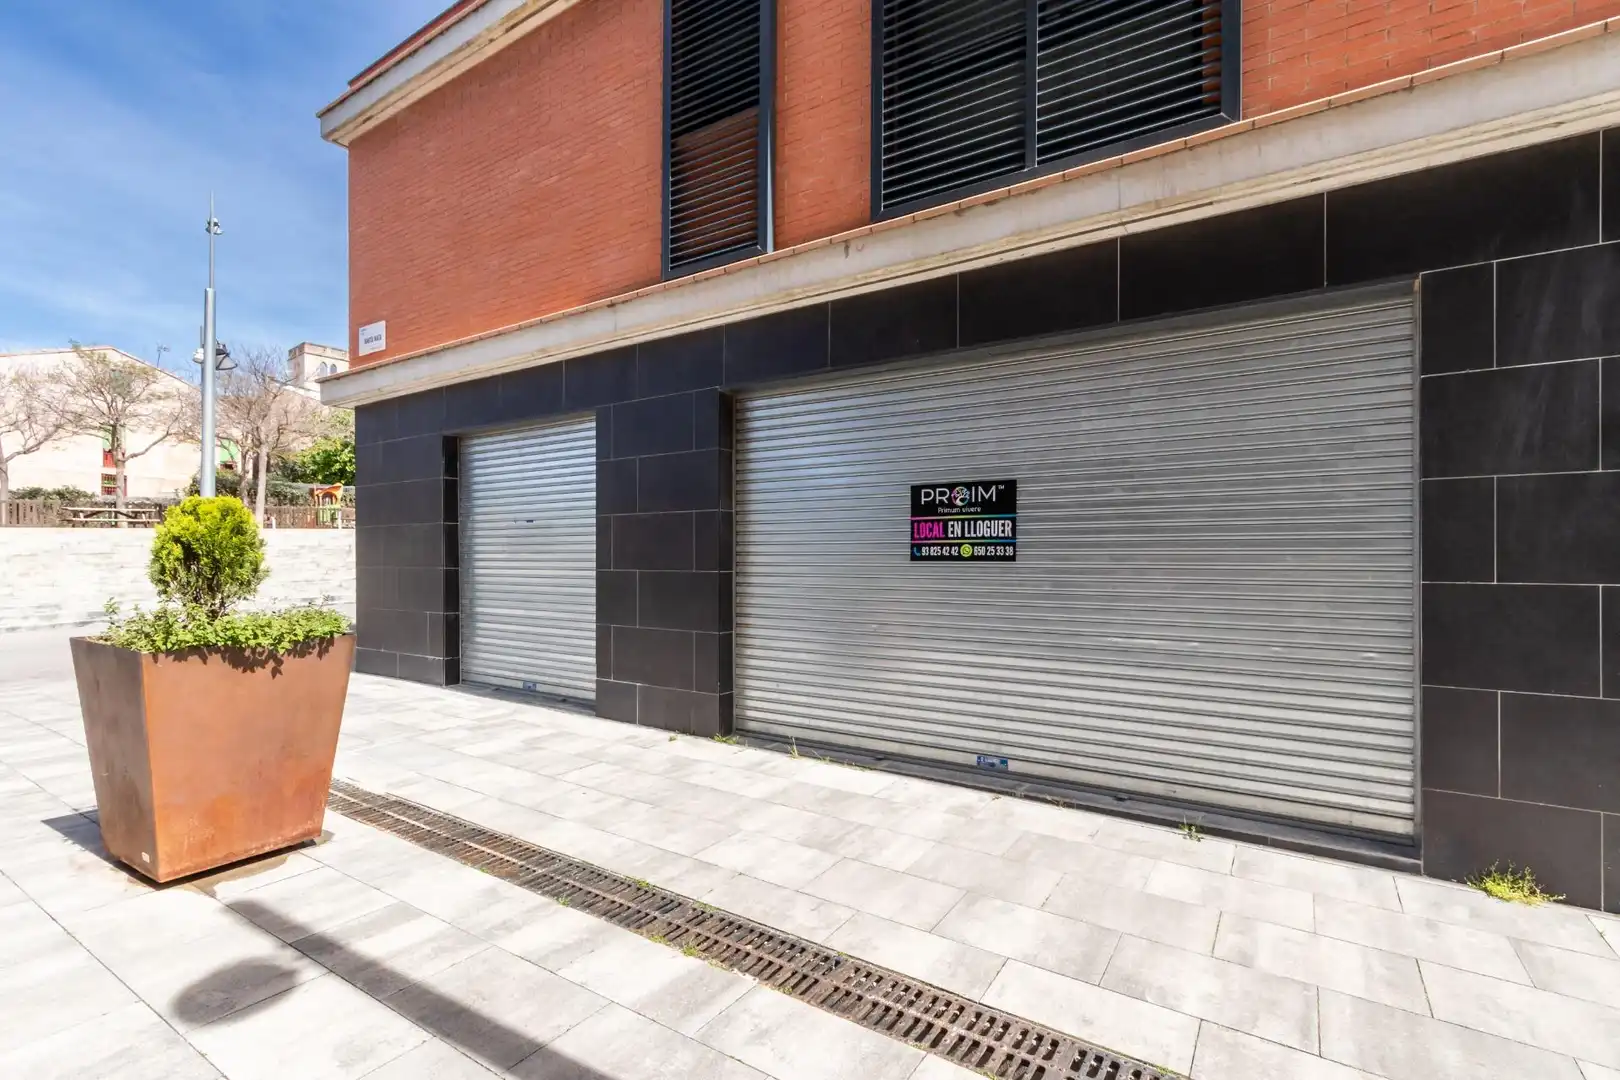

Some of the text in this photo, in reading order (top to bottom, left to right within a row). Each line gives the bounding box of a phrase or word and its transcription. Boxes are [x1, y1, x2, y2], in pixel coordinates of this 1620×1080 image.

[914, 520, 1012, 538] LOCAL EN LLOGUER
[921, 546, 959, 556] 93 825 42 42
[973, 546, 1014, 556] 650 25 33 38
